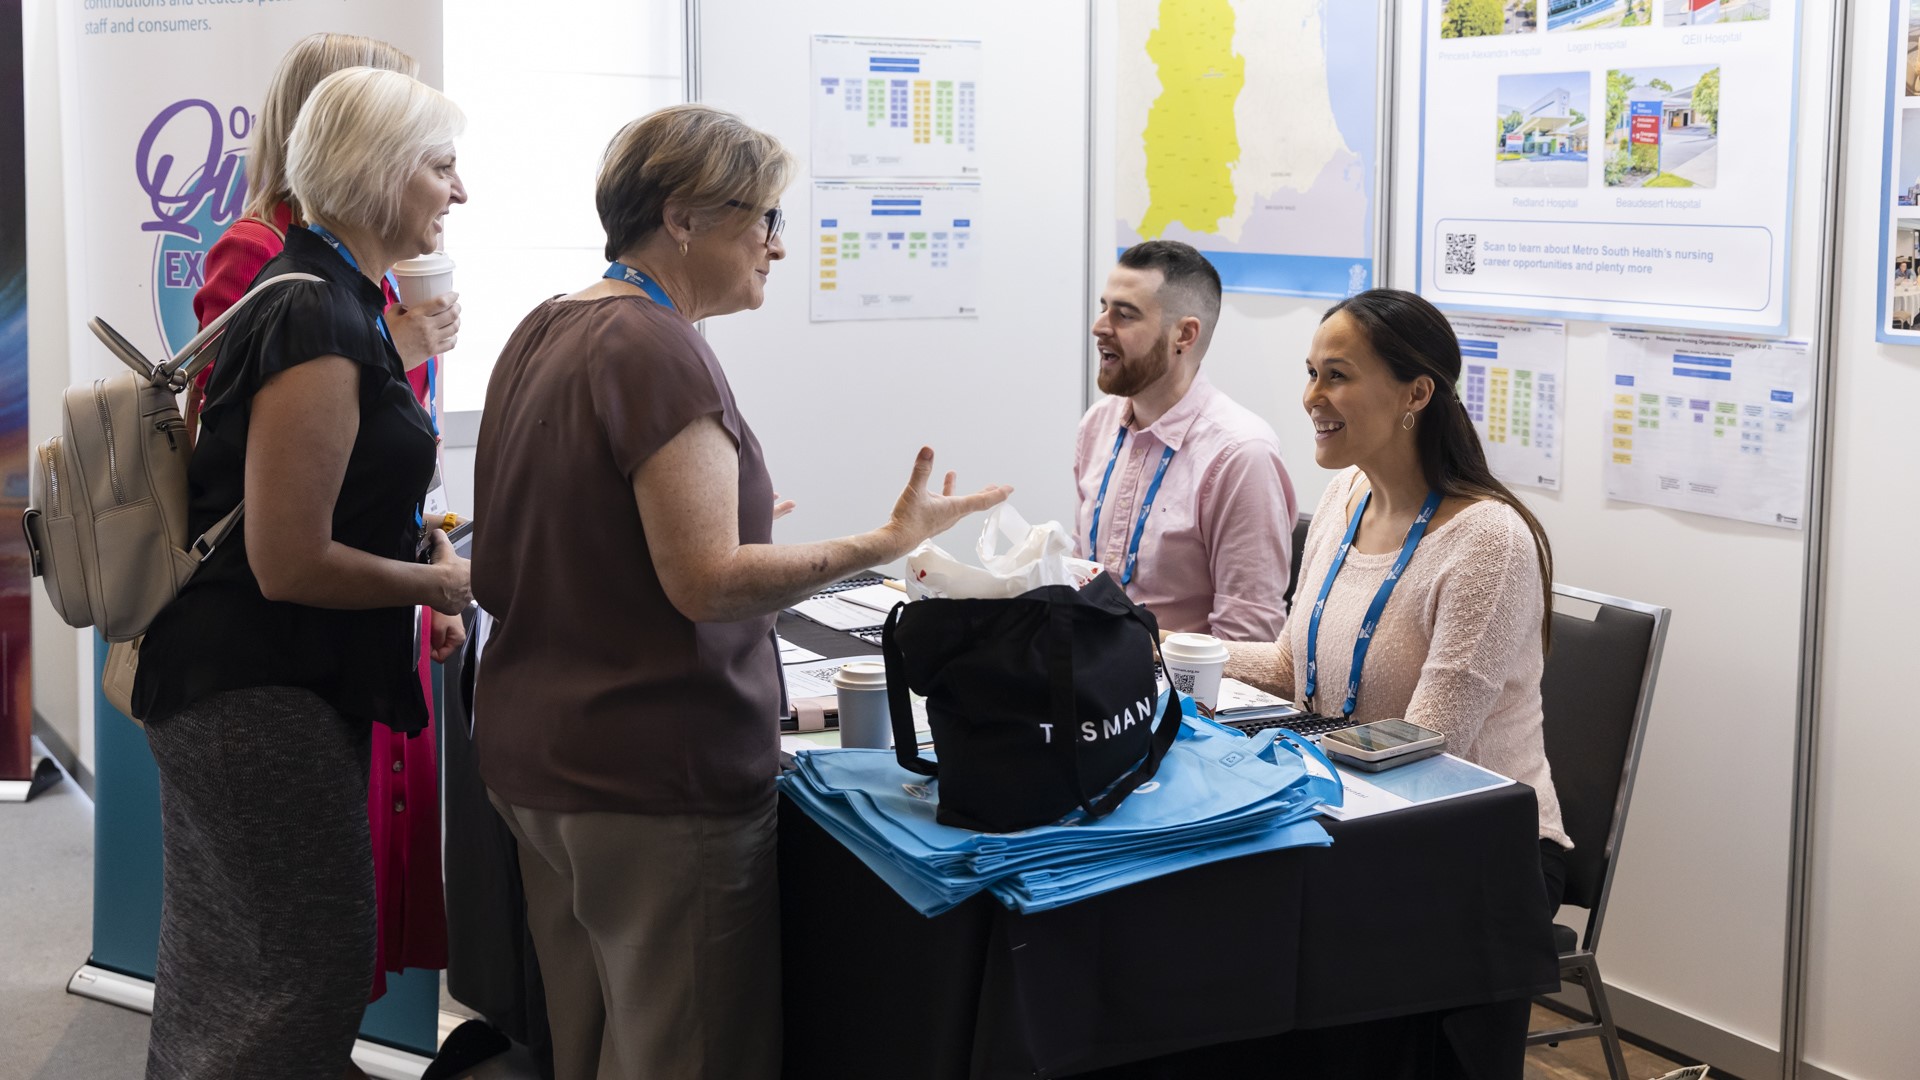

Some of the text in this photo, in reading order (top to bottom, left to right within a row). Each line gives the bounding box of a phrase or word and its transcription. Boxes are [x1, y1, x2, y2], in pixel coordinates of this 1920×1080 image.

[85, 17, 211, 34] staff and consumers.
[1567, 39, 1627, 52] Logan Hospital
[1705, 32, 1742, 44] Hospital
[1438, 47, 1542, 61] Princess Alexandra Hospital
[1513, 197, 1579, 210] Redland Hospital
[1616, 197, 1701, 210] Beaudesert Hospital
[1483, 241, 1505, 252] Scan
[1508, 243, 1517, 252] to
[1518, 243, 1541, 253] learn
[1544, 243, 1570, 254] about
[1572, 245, 1599, 256] Metro
[1601, 245, 1629, 257] South
[1675, 249, 1714, 263] nursing
[164, 251, 206, 287] EX
[1483, 257, 1653, 275] career opportunities and plenty more
[1039, 697, 1151, 743] TSMAN
